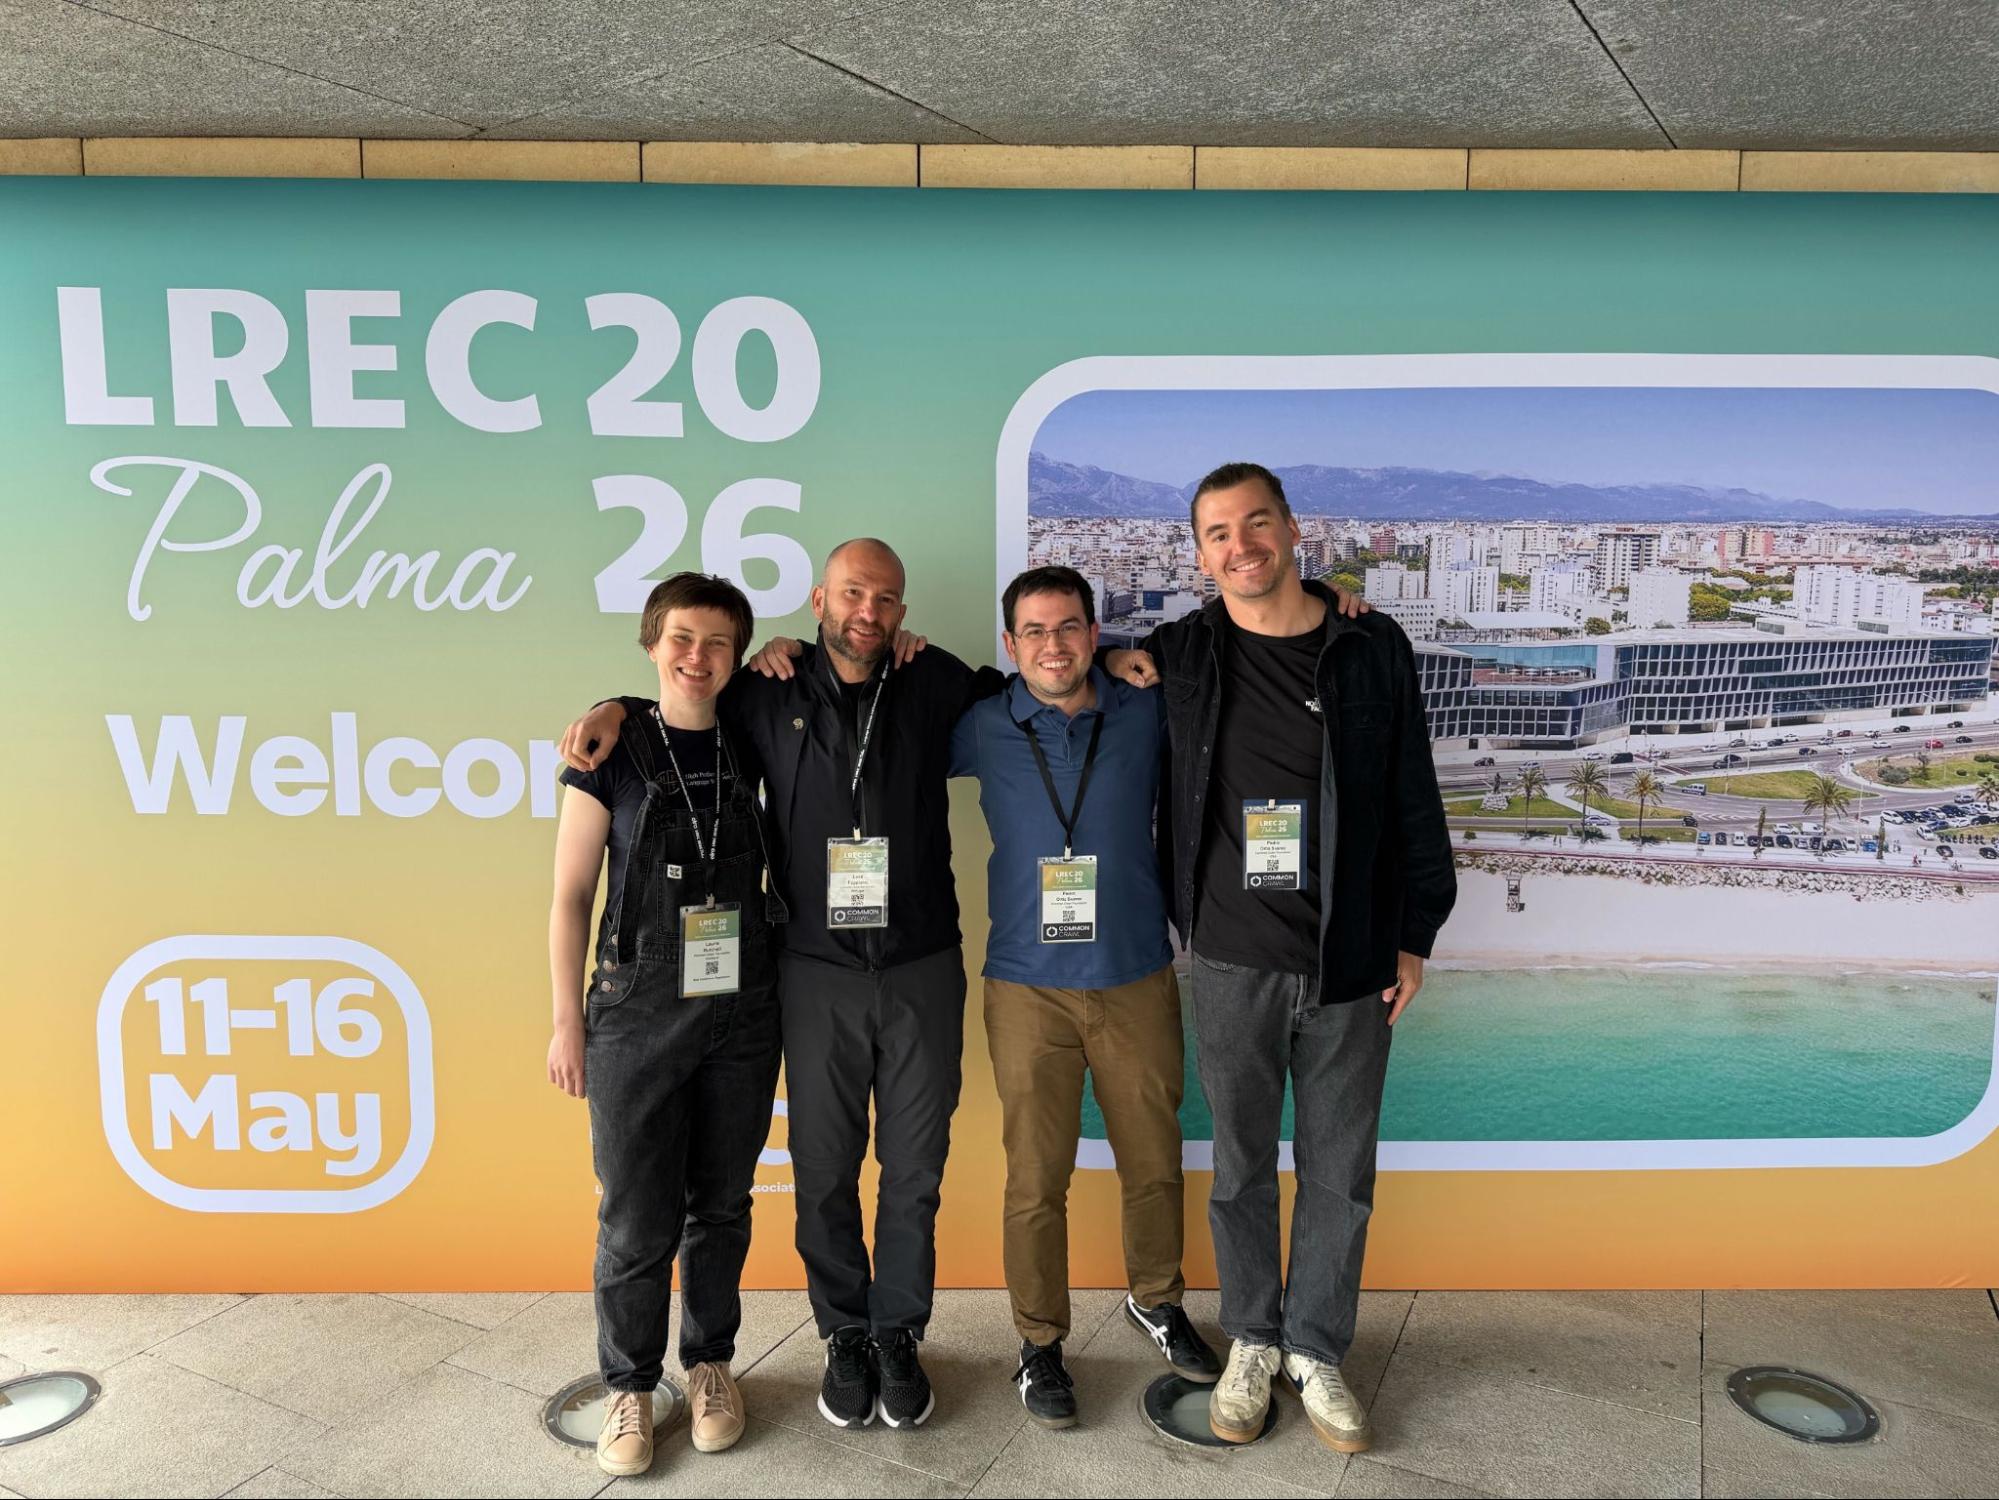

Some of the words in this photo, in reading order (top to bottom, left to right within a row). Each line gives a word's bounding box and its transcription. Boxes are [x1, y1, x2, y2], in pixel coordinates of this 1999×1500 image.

[56, 286, 542, 433] LREC
[584, 292, 821, 442] 20
[89, 455, 533, 621] Palma
[591, 474, 813, 618] 26
[847, 908, 880, 916] COMMON
[149, 1073, 383, 1177] May
